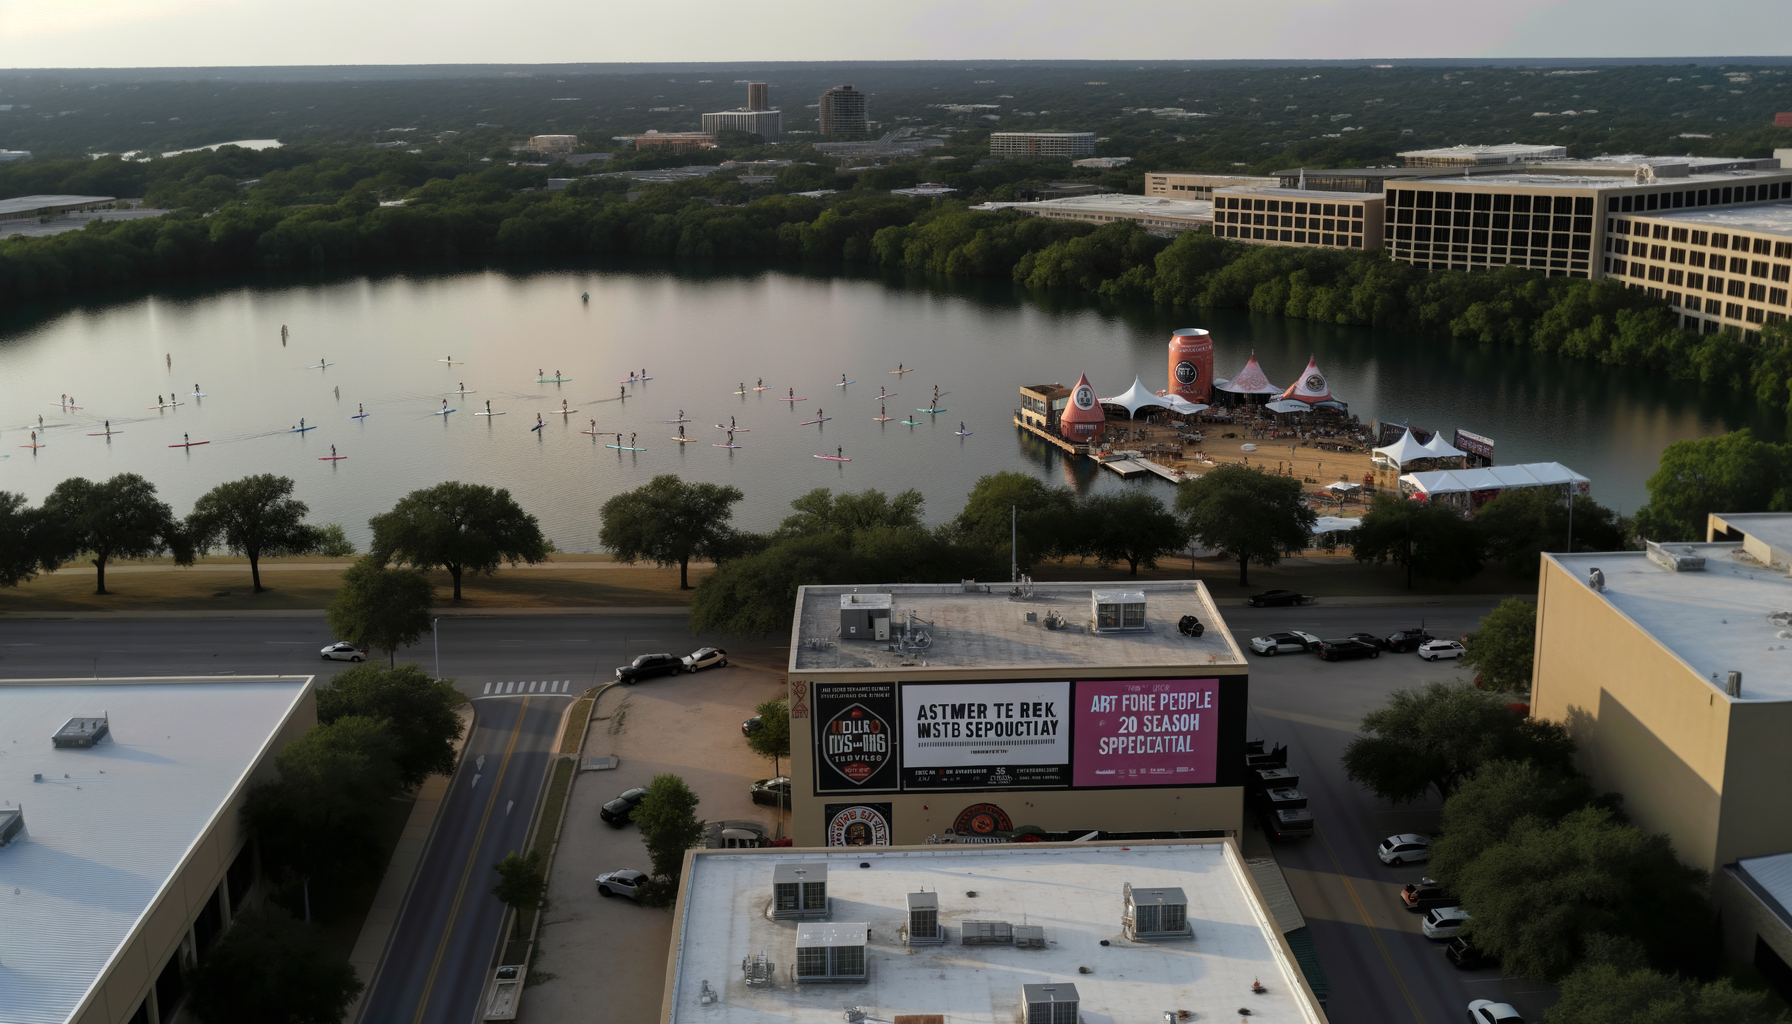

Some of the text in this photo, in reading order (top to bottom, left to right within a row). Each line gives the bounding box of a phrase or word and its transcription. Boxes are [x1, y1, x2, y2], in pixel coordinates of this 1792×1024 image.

[917, 703, 988, 720] ASTMER
[993, 703, 1014, 718] TE
[1118, 716, 1138, 734] 20
